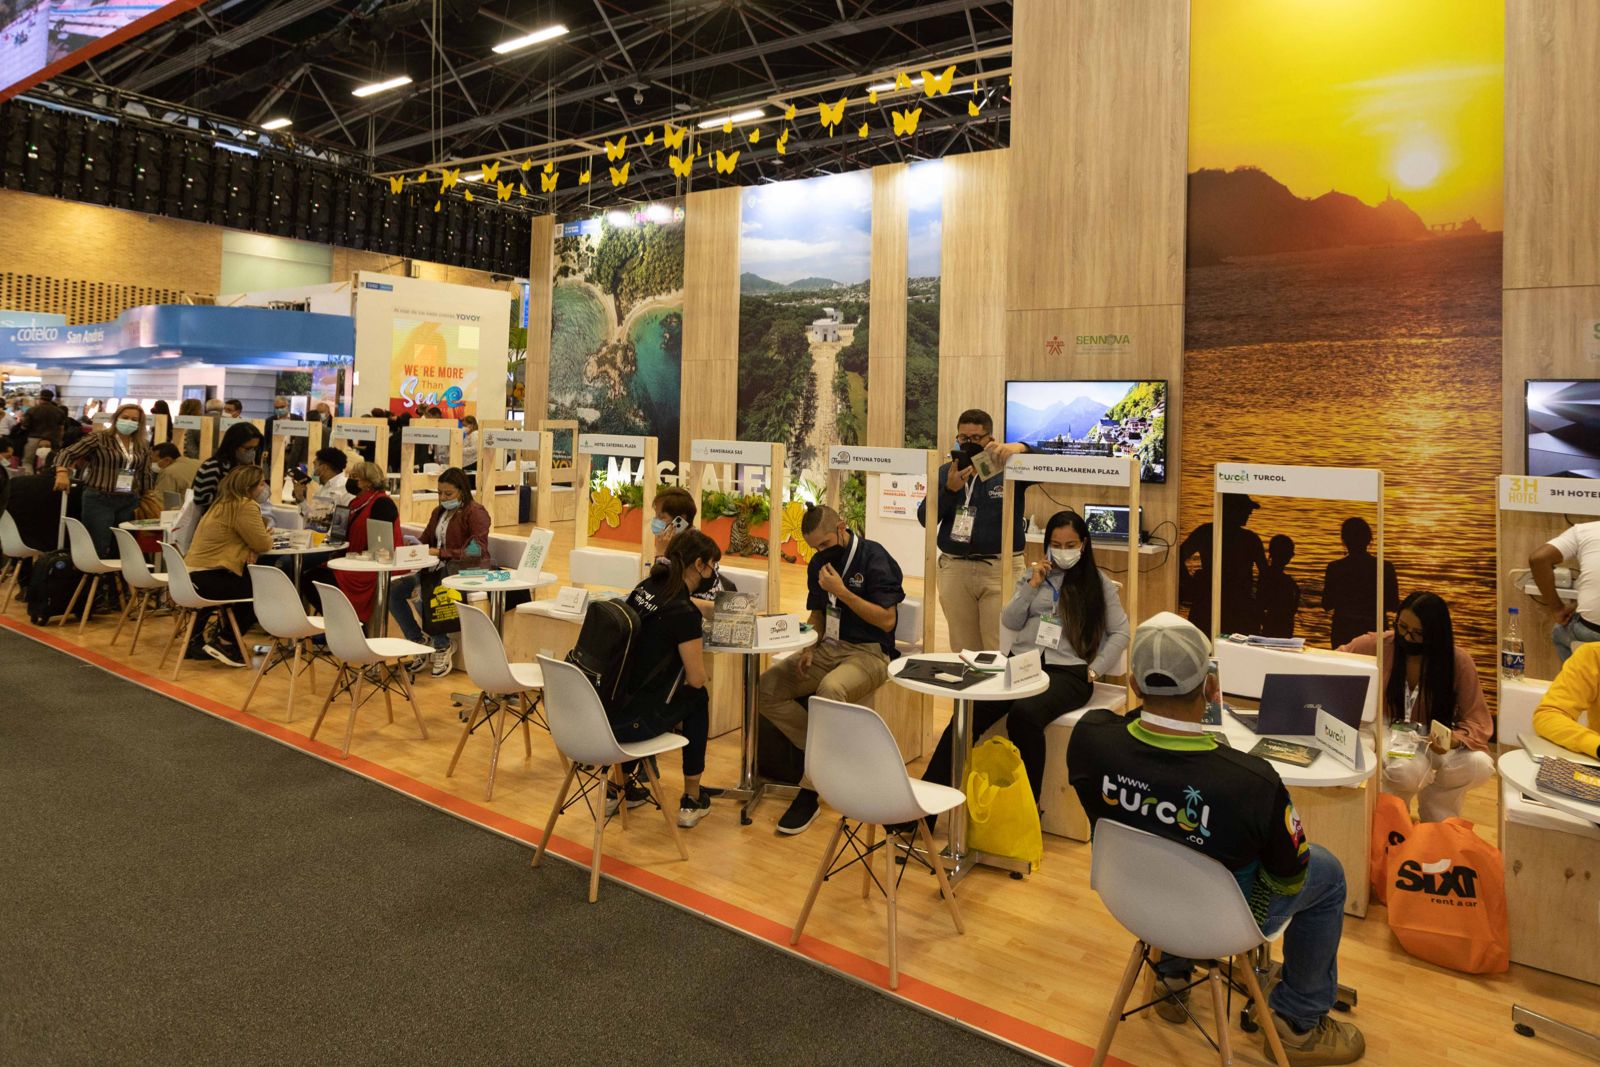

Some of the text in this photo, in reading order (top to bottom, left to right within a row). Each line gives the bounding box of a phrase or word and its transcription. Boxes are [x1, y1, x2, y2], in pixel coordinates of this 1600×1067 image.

[456, 313, 480, 322] YOVOY
[66, 331, 82, 344] San
[1076, 334, 1130, 346] SENNOVA
[438, 367, 464, 379] MORE
[422, 380, 443, 390] Than
[1055, 466, 1096, 474] PALMARENA
[1254, 474, 1286, 482] TURCOL
[1508, 478, 1538, 504] 3H HOTEL
[1117, 774, 1151, 792] www.
[1102, 775, 1211, 837] turcol
[1395, 859, 1477, 898] SIXT
[1431, 897, 1454, 907] rent
